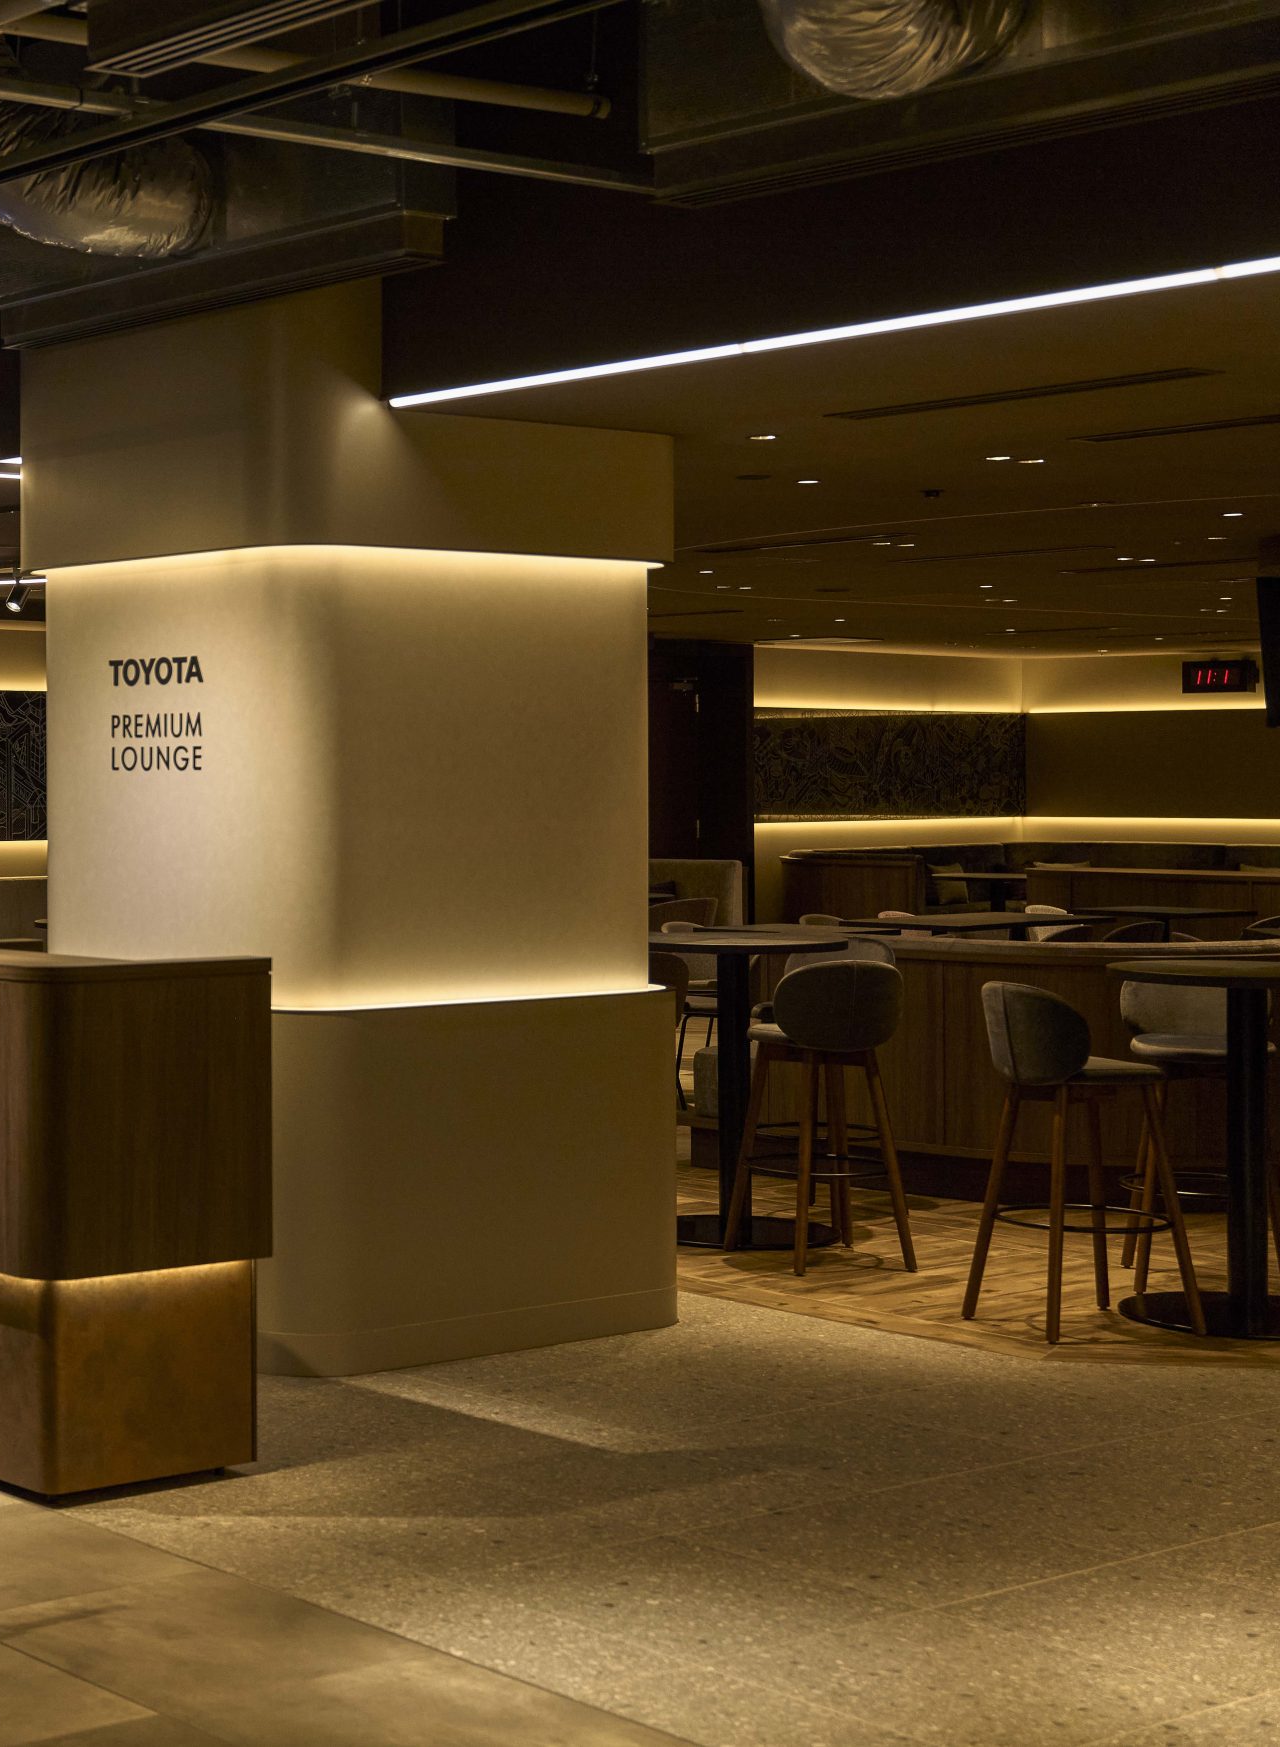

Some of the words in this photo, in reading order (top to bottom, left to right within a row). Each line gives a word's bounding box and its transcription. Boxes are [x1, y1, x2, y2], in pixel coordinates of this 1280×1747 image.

[109, 656, 204, 686] TOYOTA
[111, 711, 202, 738] PREMIUM
[111, 745, 202, 771] LOUNGE
